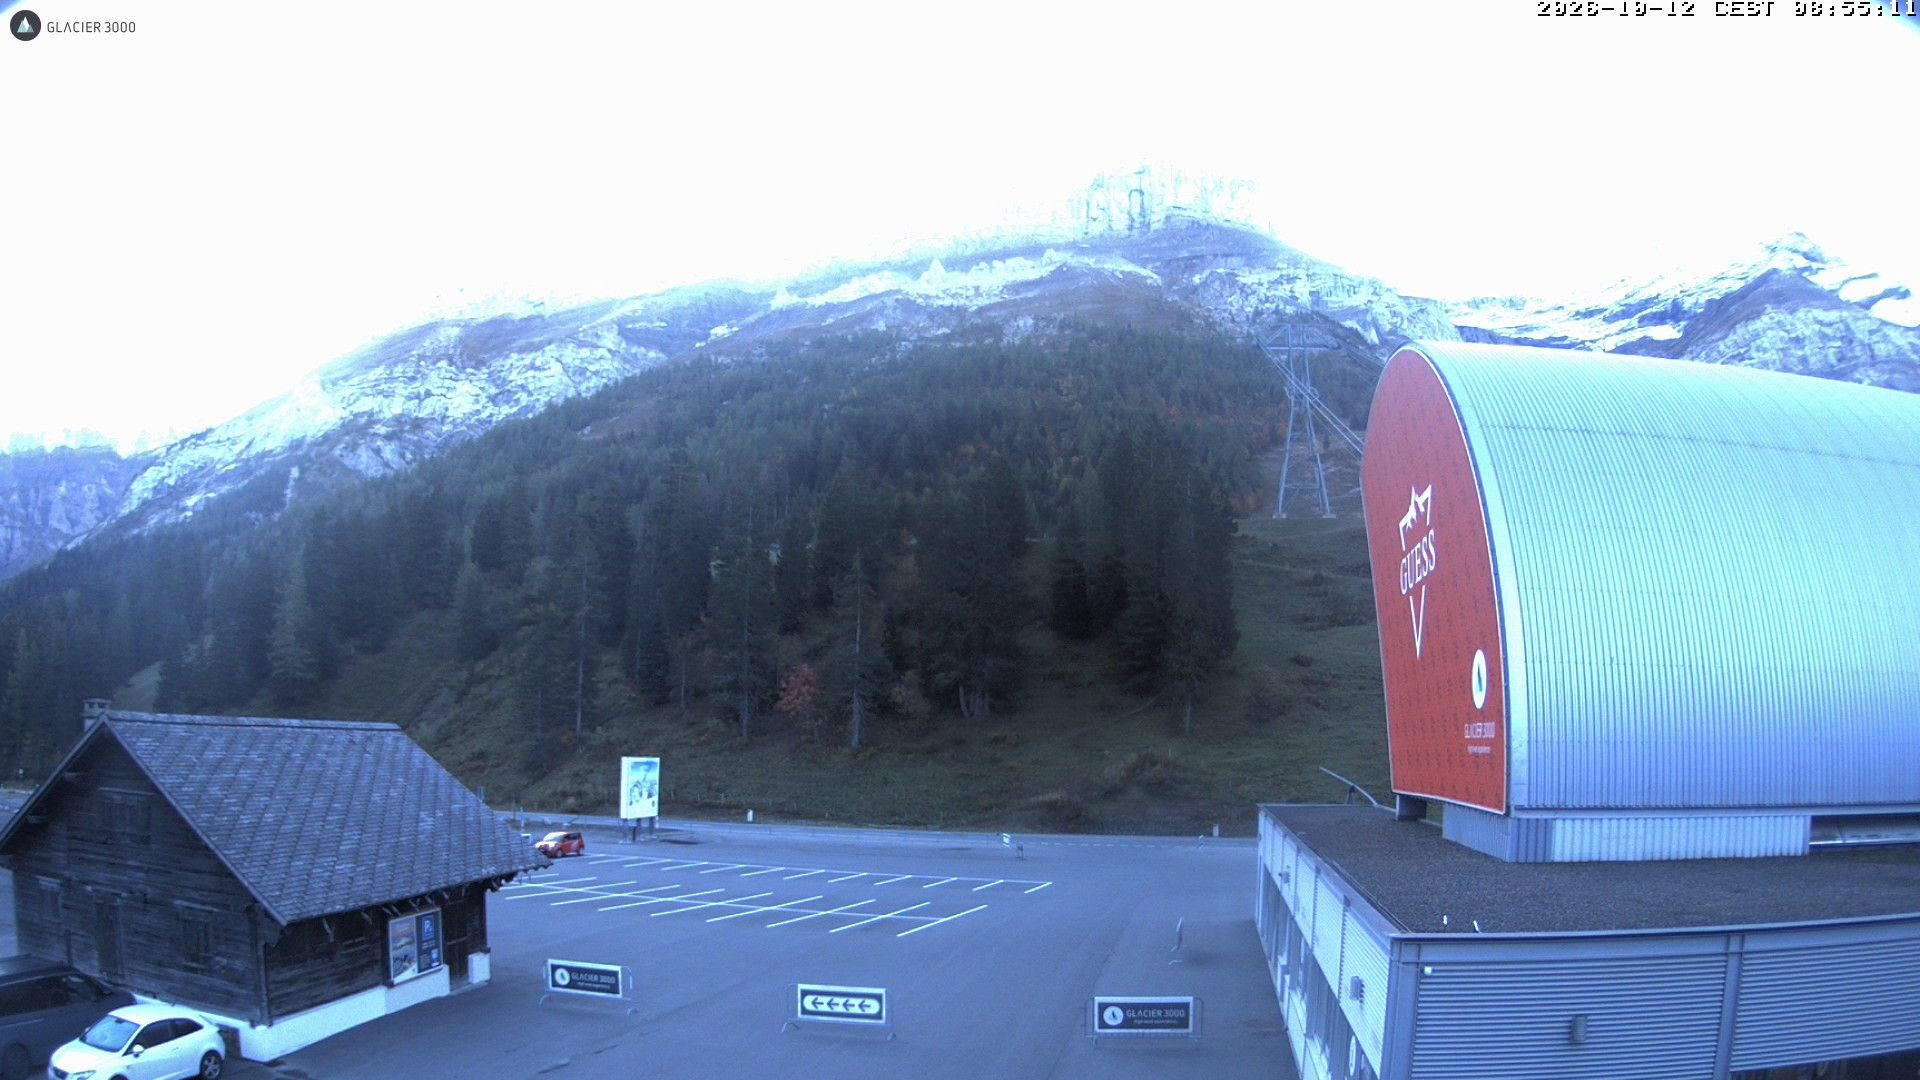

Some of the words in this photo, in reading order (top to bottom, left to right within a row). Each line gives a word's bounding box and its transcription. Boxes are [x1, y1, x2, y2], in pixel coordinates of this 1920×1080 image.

[1400, 529, 1436, 595] GUESS
[571, 972, 599, 982] GLACIER
[1126, 1008, 1163, 1018] GLACIER
[1163, 1008, 1185, 1018] 3000
